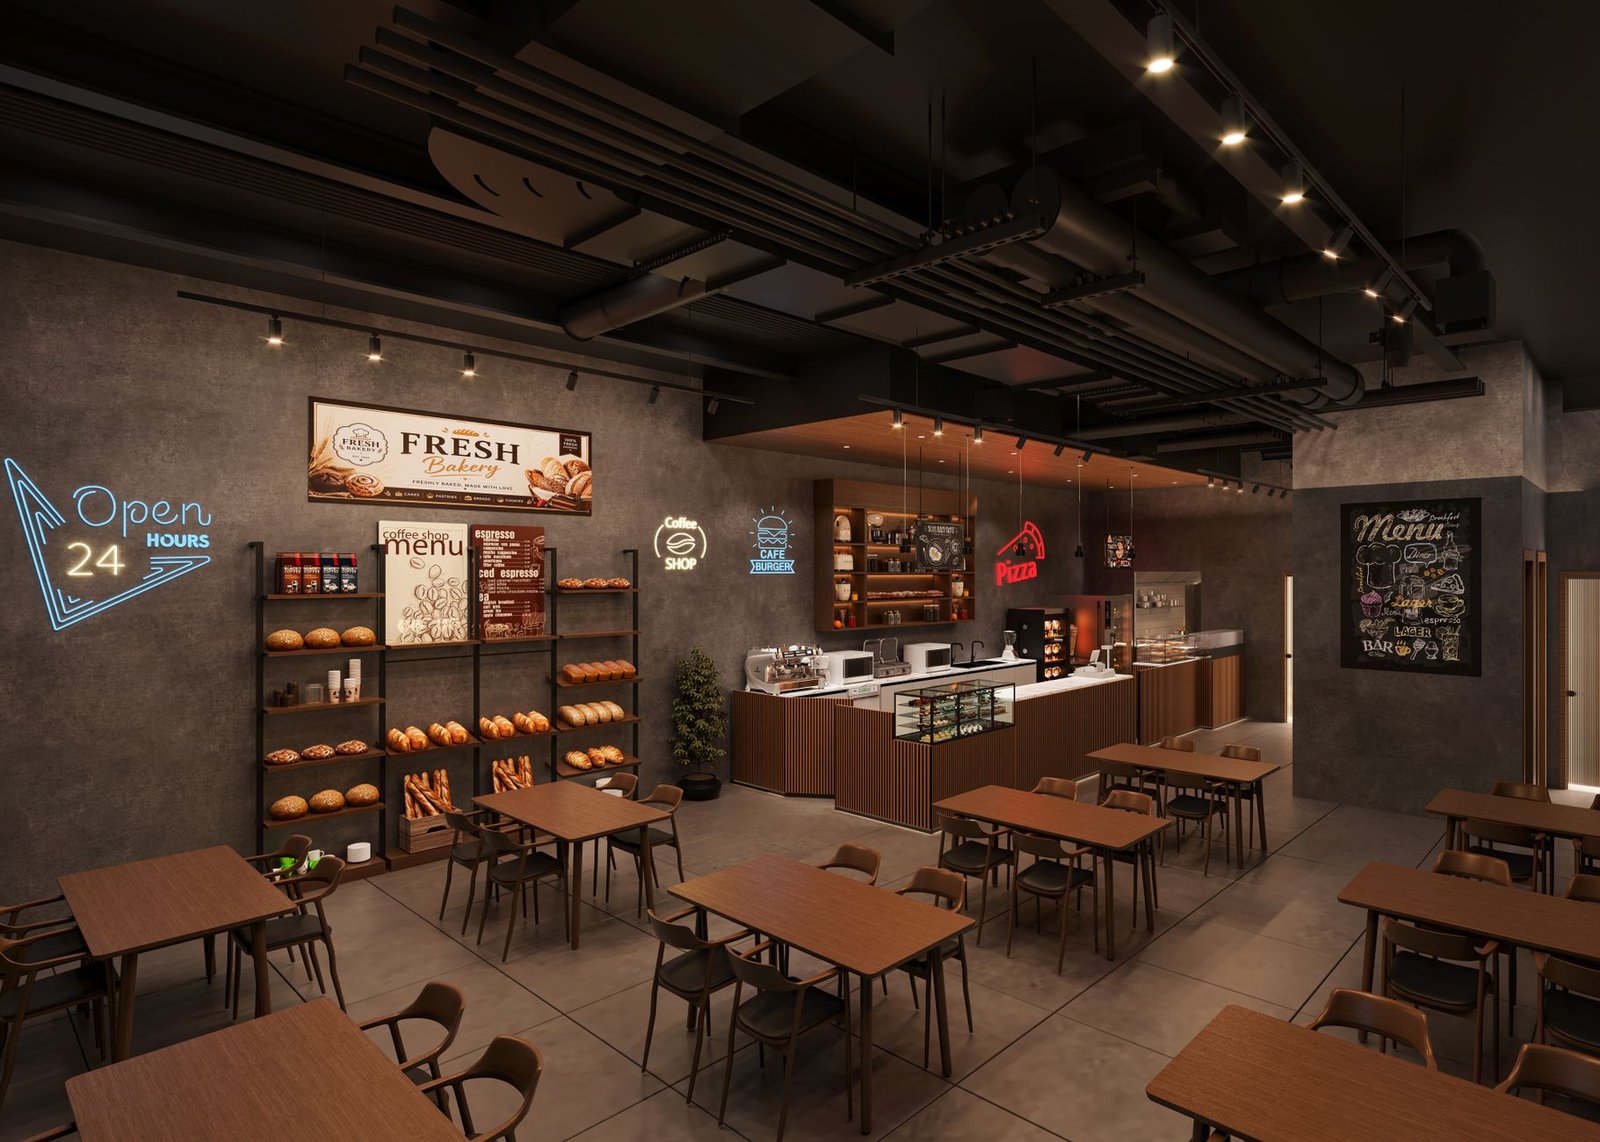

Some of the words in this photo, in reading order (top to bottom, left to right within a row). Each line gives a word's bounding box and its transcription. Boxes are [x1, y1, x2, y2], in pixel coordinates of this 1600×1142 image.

[342, 438, 380, 448] FRESH
[400, 431, 520, 466] FRESH
[422, 455, 502, 479] Bakery
[72, 485, 212, 538] Open
[664, 516, 698, 529] Coffee
[1354, 513, 1444, 541] Menu
[146, 532, 210, 549] HOURS
[383, 528, 419, 540] coffee
[422, 529, 450, 541] shop
[475, 529, 515, 540] espresso
[384, 538, 463, 556] menu
[67, 542, 126, 576] 24
[760, 550, 785, 560] CAFE
[664, 557, 697, 570] SHOP
[755, 562, 791, 572] BURGER
[479, 568, 495, 578] ced
[500, 569, 539, 579] espresso
[995, 559, 1038, 587] Pizza
[479, 593, 490, 602] ea
[1424, 617, 1461, 625] espresso
[1393, 626, 1432, 638] LAGER
[1362, 639, 1394, 654] BAR
